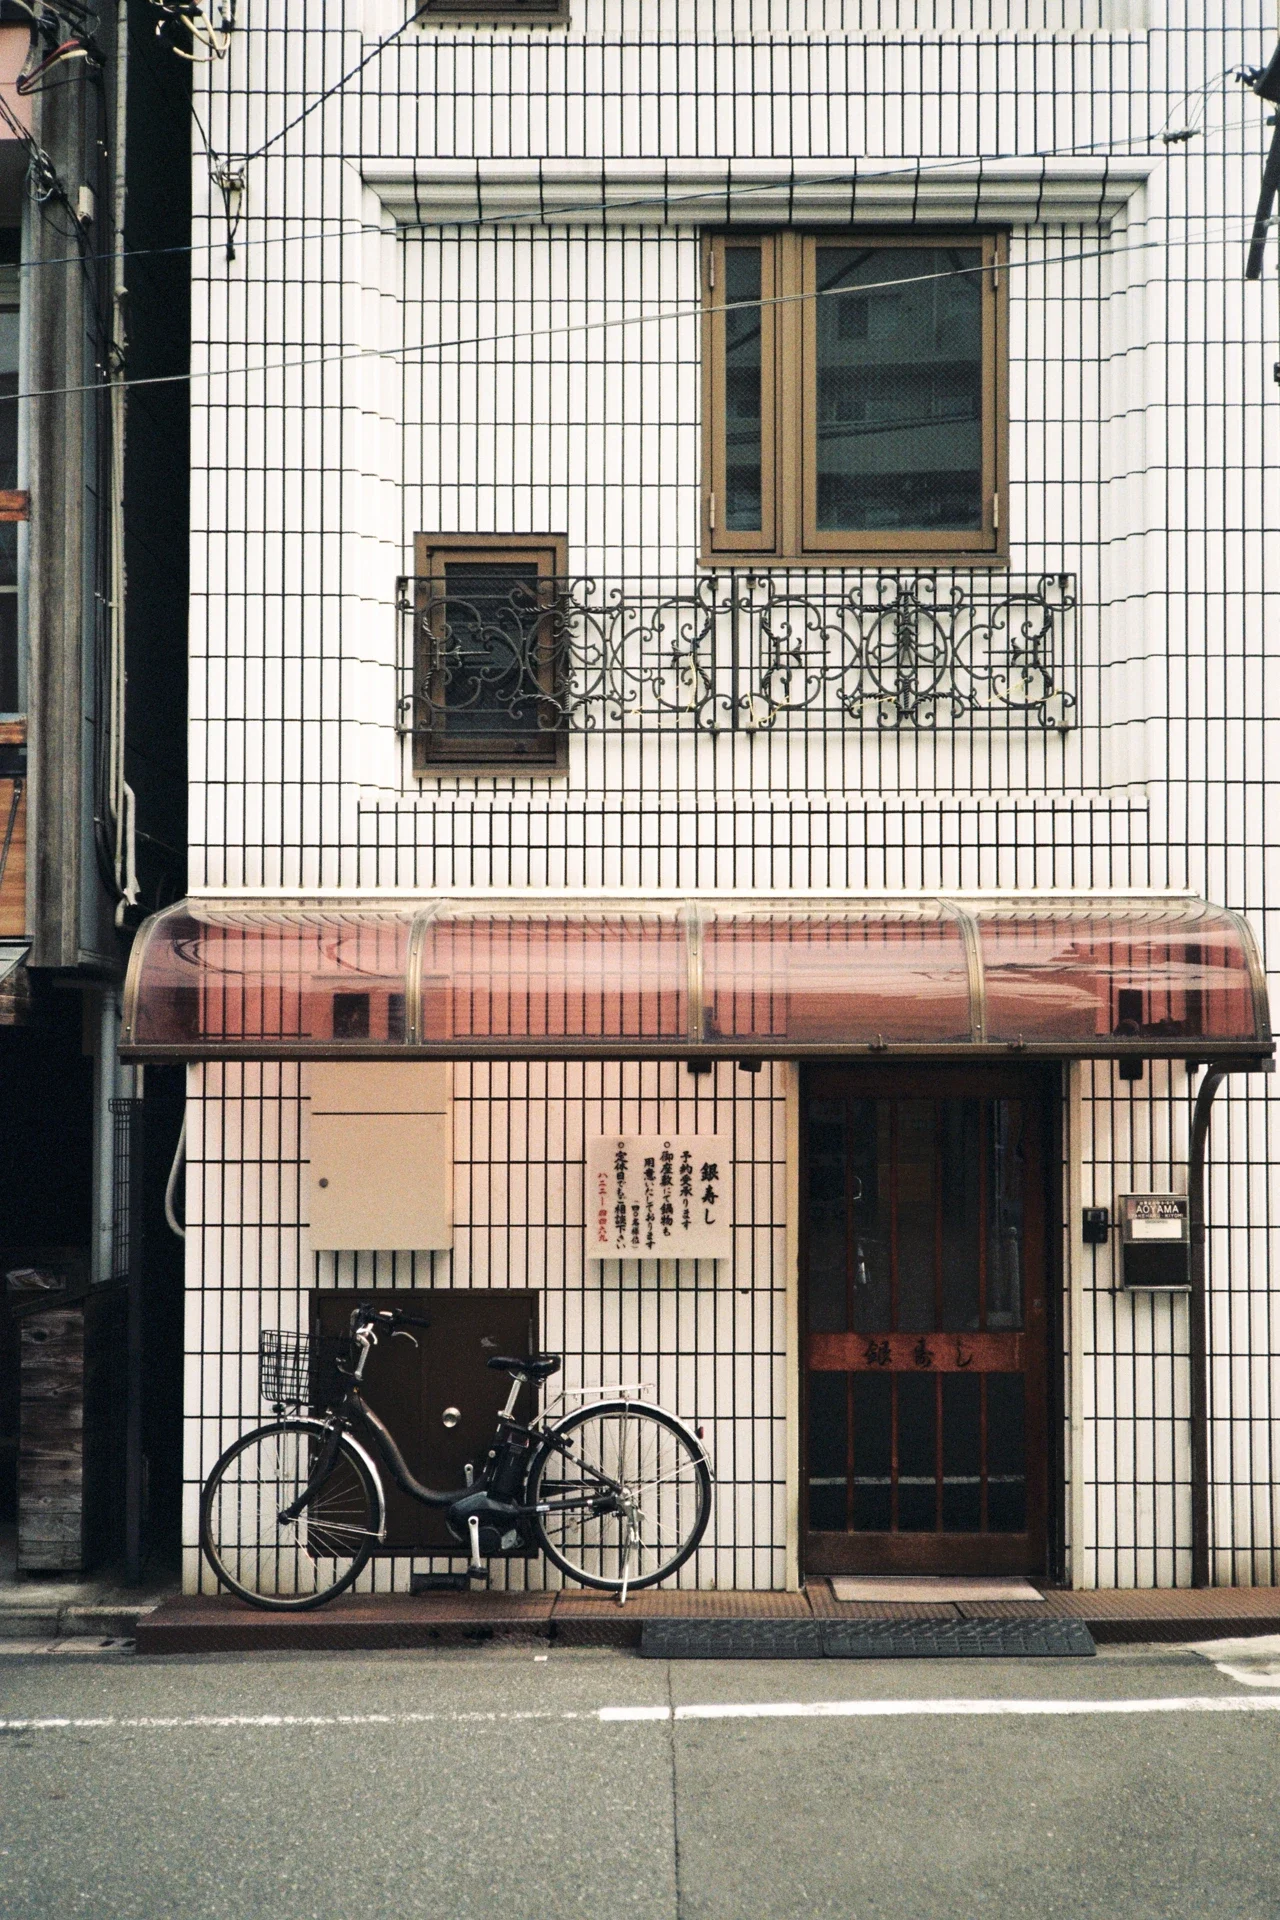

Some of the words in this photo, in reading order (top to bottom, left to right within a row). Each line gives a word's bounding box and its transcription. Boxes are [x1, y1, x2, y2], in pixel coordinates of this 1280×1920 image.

[643, 1157, 656, 1250] 用意いたしております
[700, 1161, 719, 1225] 銀寿し
[1136, 1205, 1179, 1213] AOYAMA
